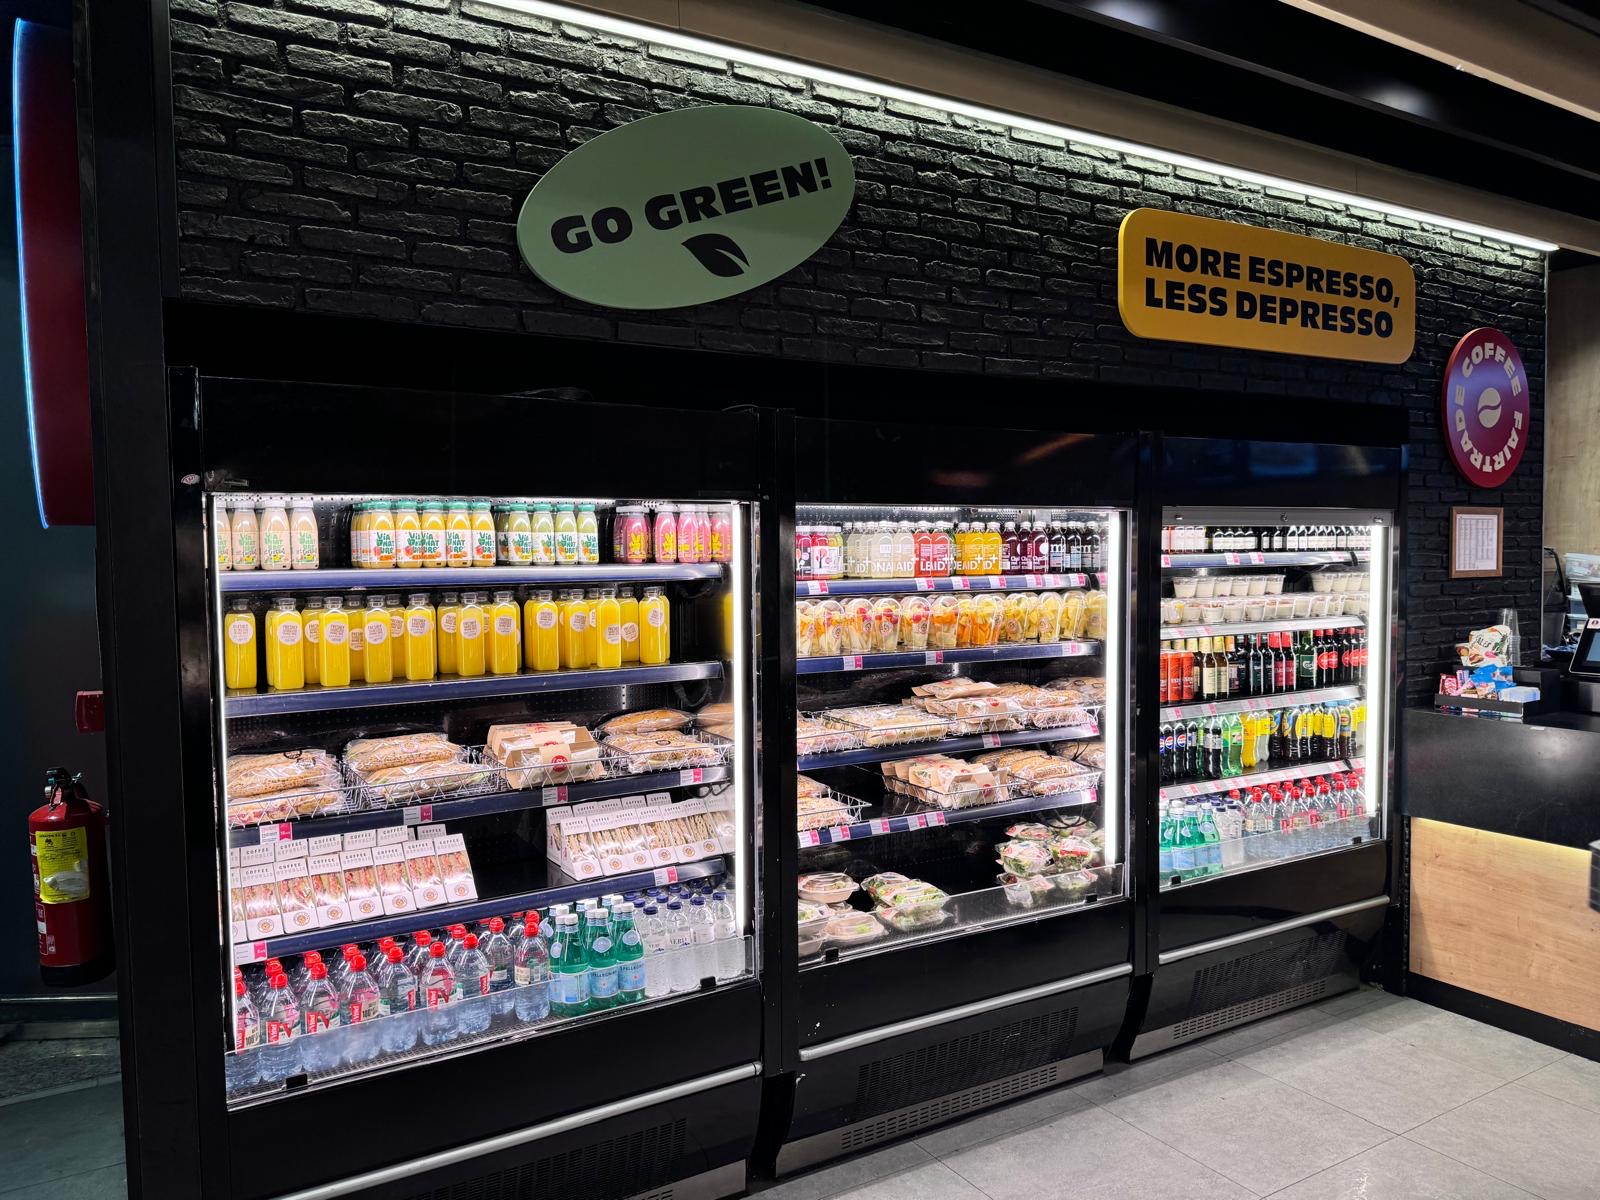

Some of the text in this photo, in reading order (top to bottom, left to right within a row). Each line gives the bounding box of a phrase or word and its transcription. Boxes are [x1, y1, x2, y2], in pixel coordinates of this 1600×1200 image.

[550, 157, 832, 254] GO GREEN!
[1145, 237, 1400, 308] MORE ESPRESSO,
[1145, 277, 1394, 339] LESS DEPRESSO
[1462, 342, 1522, 397] COFFEE
[1454, 384, 1523, 473] FAIRTRADE
